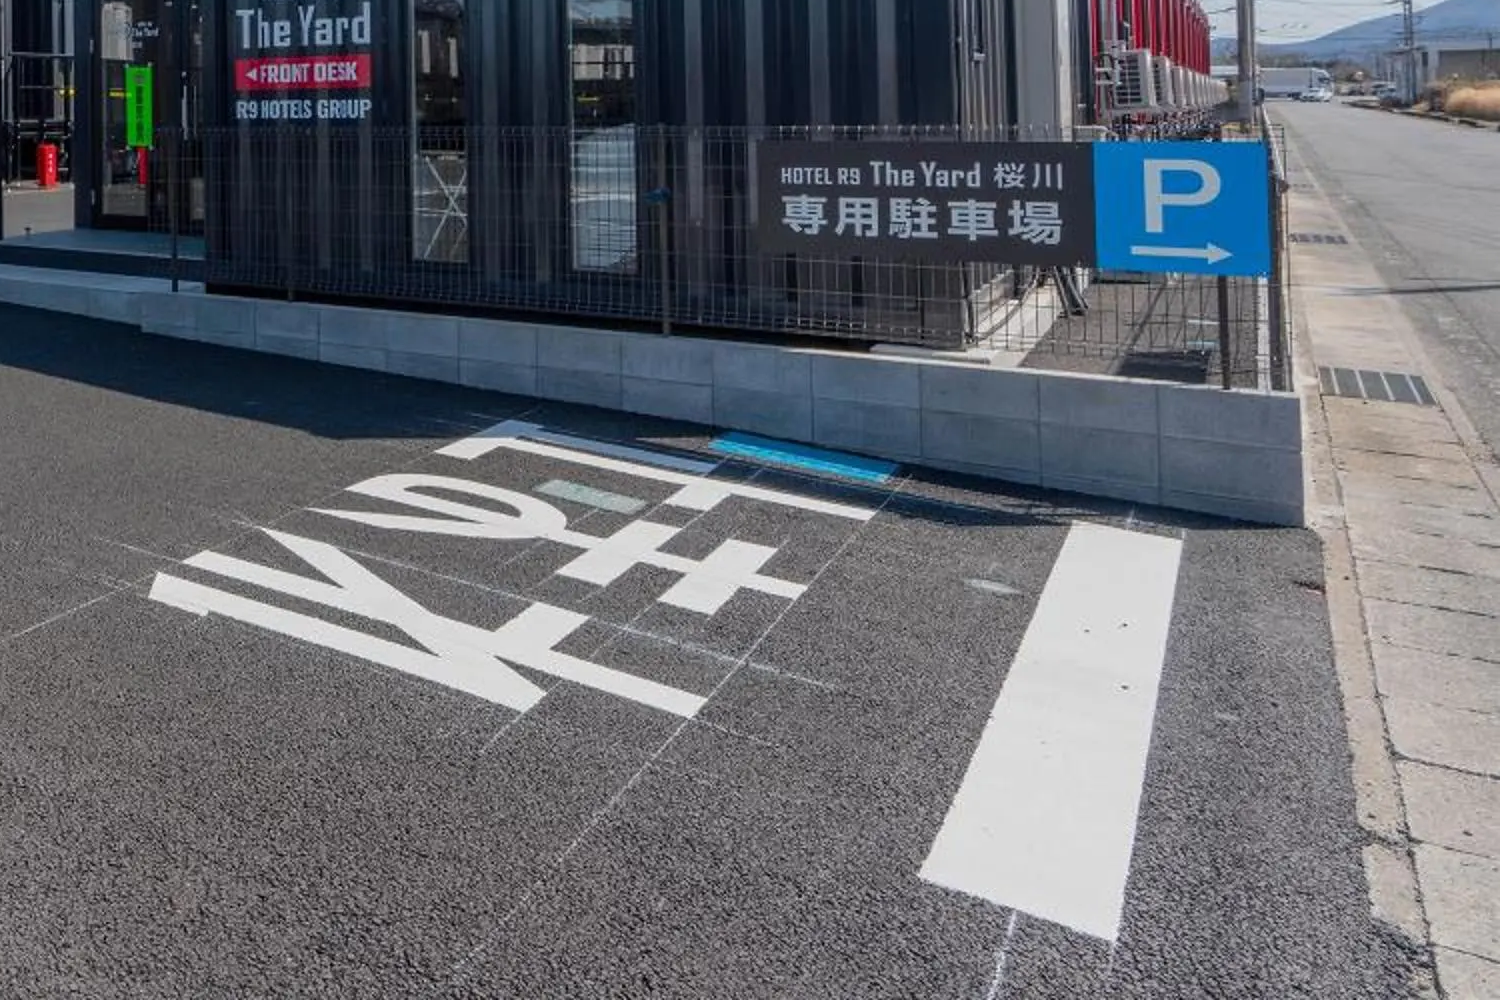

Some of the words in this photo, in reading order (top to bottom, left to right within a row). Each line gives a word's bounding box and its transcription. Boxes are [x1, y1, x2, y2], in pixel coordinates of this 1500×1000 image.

[235, 7, 291, 49] The
[298, 1, 371, 47] Yard
[259, 63, 310, 84] FRONT
[314, 62, 357, 82] DESK
[236, 101, 257, 119] R9
[261, 100, 312, 119] HOTELS
[316, 99, 373, 119] GROUP
[781, 167, 832, 186] HOTEL
[837, 167, 861, 186] R9
[870, 161, 915, 187] The
[920, 161, 981, 188] Yard
[993, 161, 1064, 191] 桜川
[1143, 159, 1221, 233] P
[781, 194, 1064, 246] 専用駐車場
